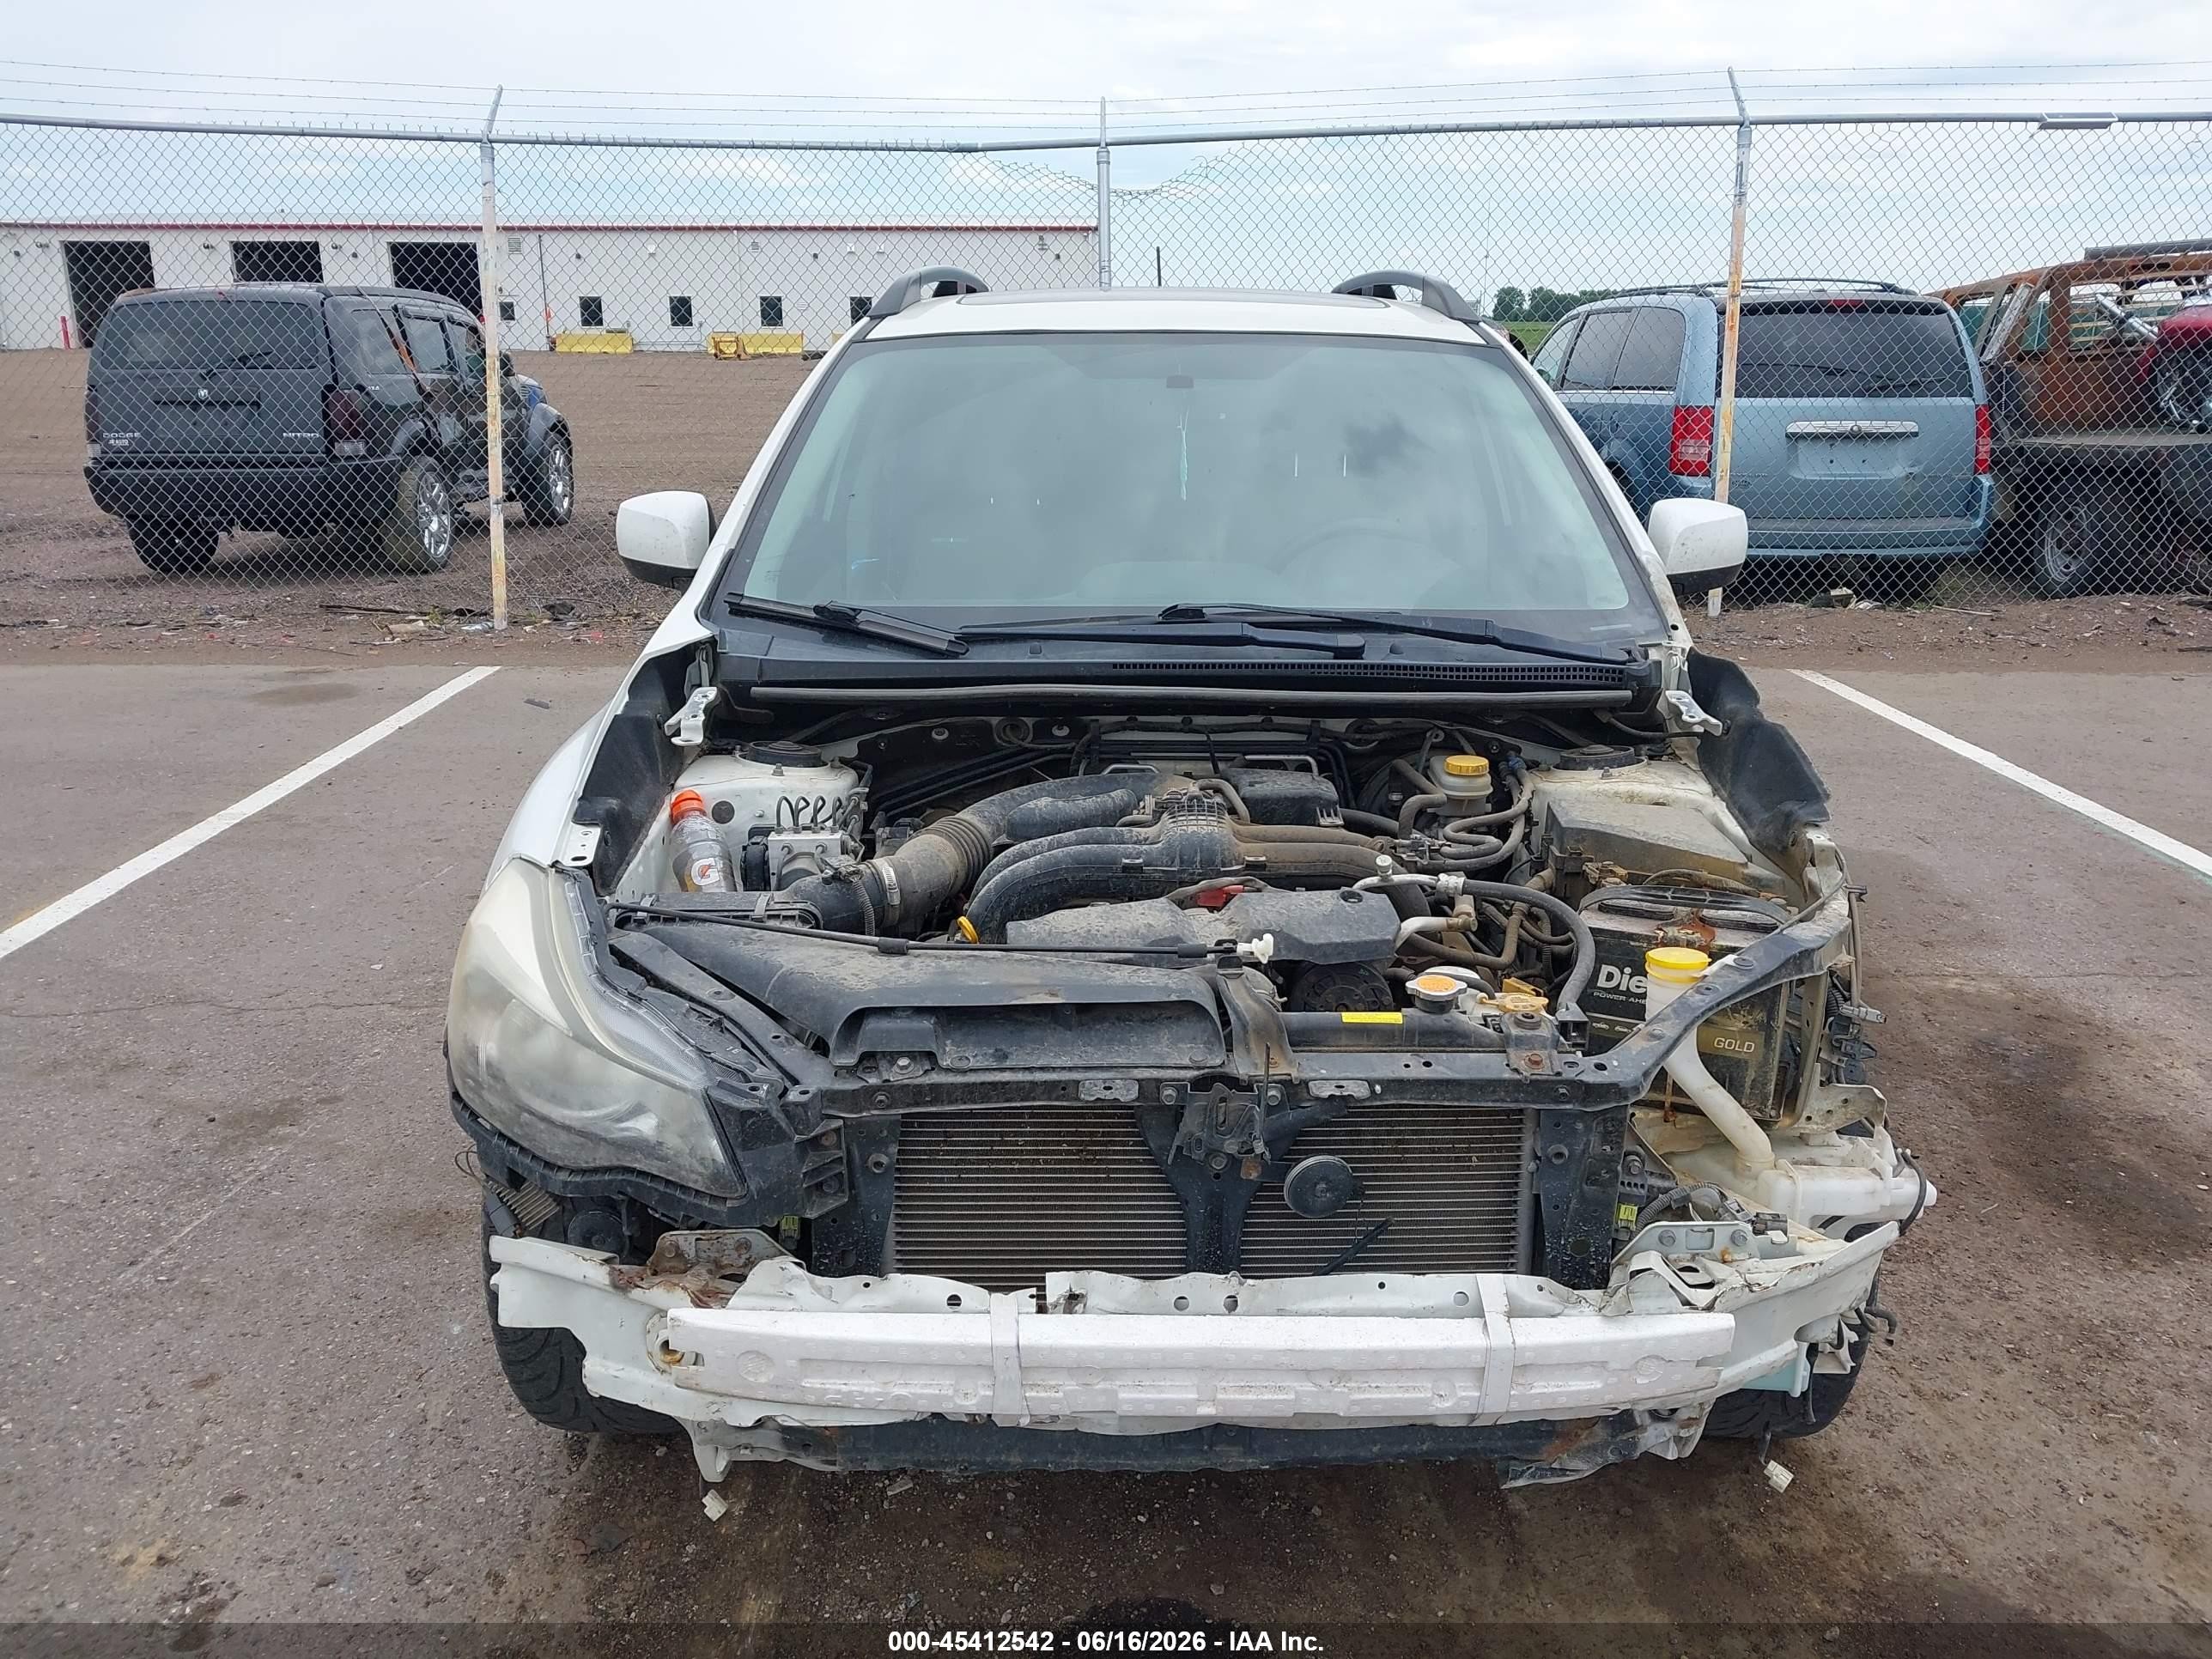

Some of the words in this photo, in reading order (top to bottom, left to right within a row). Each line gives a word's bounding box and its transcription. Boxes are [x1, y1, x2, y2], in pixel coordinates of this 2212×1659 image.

[690, 857, 720, 886] G
[1593, 991, 1627, 1001] POWER
[1714, 1036, 1755, 1053] GOLD
